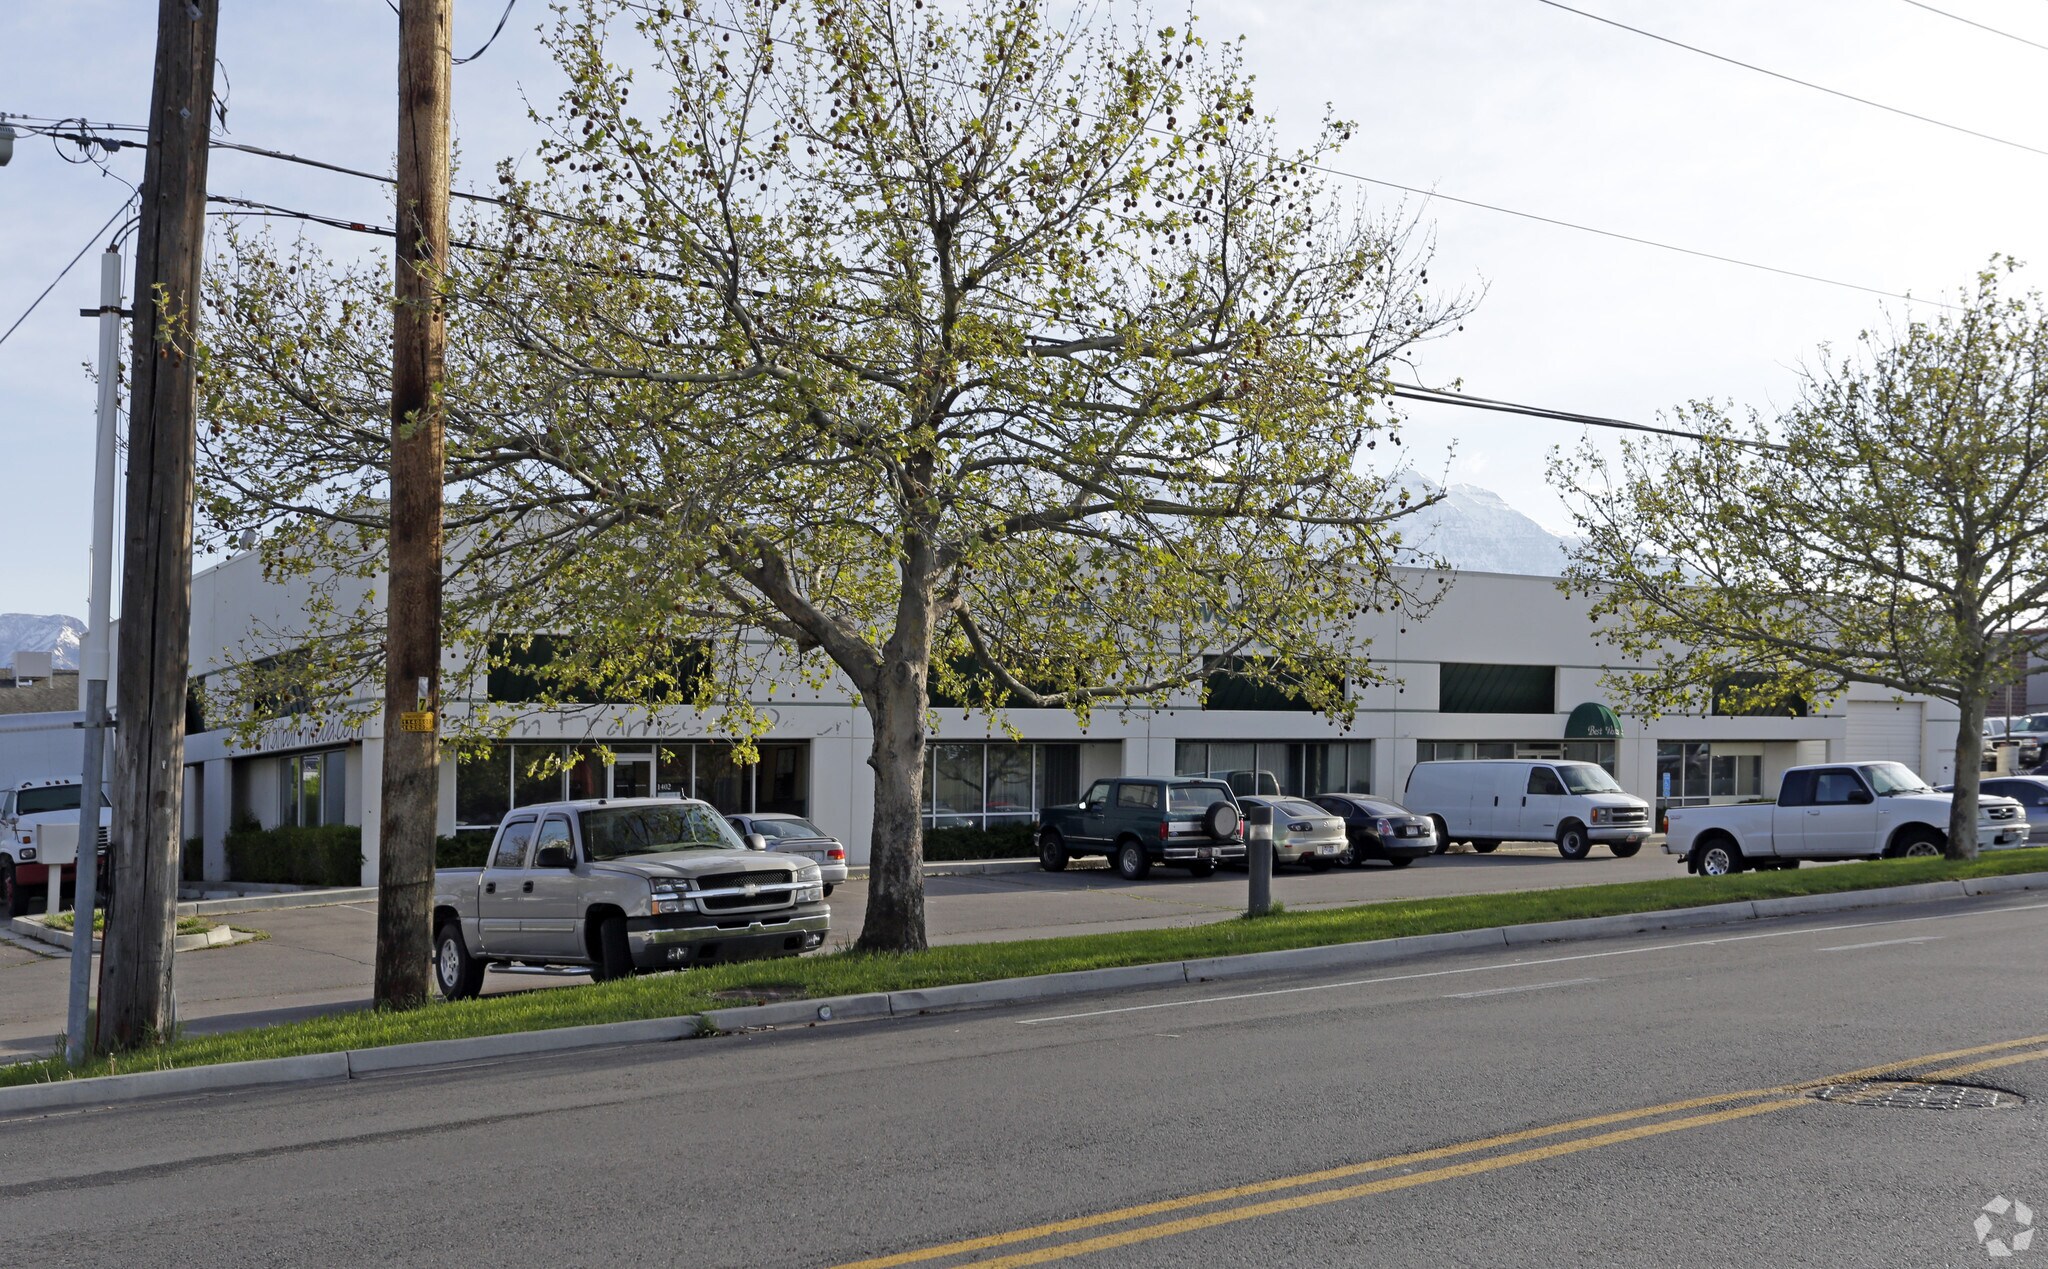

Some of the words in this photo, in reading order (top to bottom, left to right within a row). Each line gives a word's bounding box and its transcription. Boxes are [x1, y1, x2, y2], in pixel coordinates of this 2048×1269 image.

[418, 697, 427, 711] 7
[1587, 724, 1603, 736] Best
[657, 783, 672, 791] 1402
